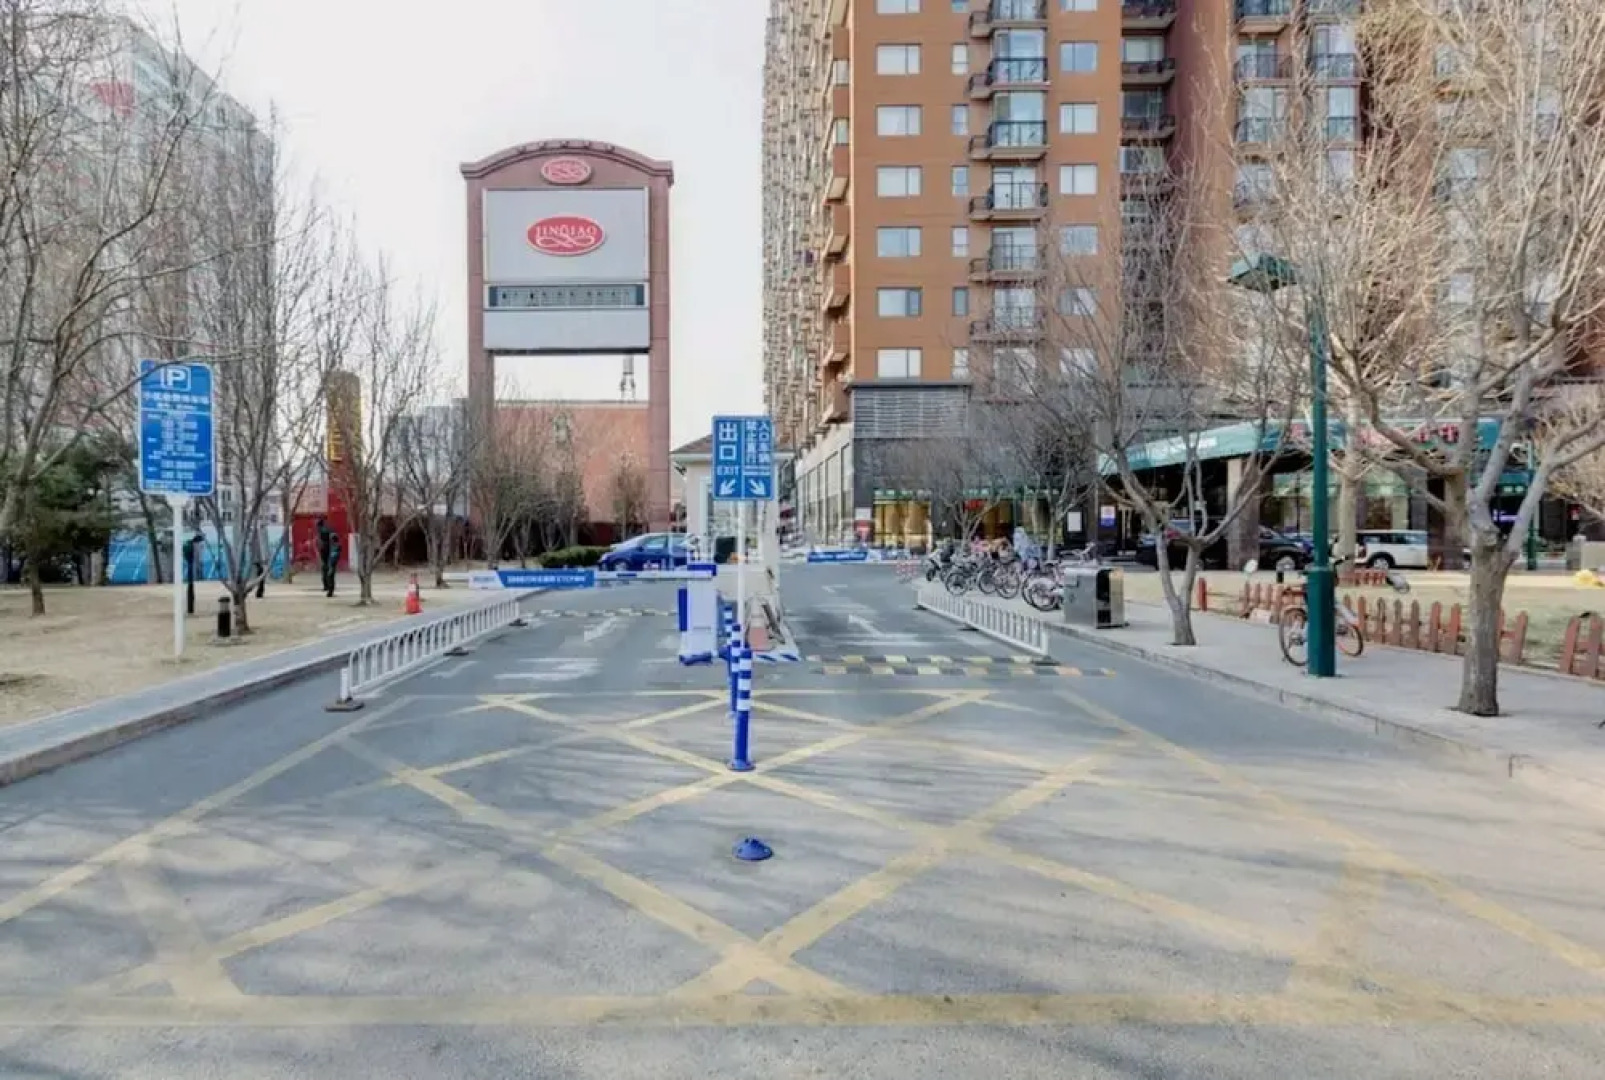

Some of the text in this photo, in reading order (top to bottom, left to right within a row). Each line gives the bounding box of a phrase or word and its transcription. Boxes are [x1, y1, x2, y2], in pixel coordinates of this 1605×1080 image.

[167, 368, 186, 386] P
[718, 421, 738, 460] 出口
[717, 466, 738, 475] EXIT
